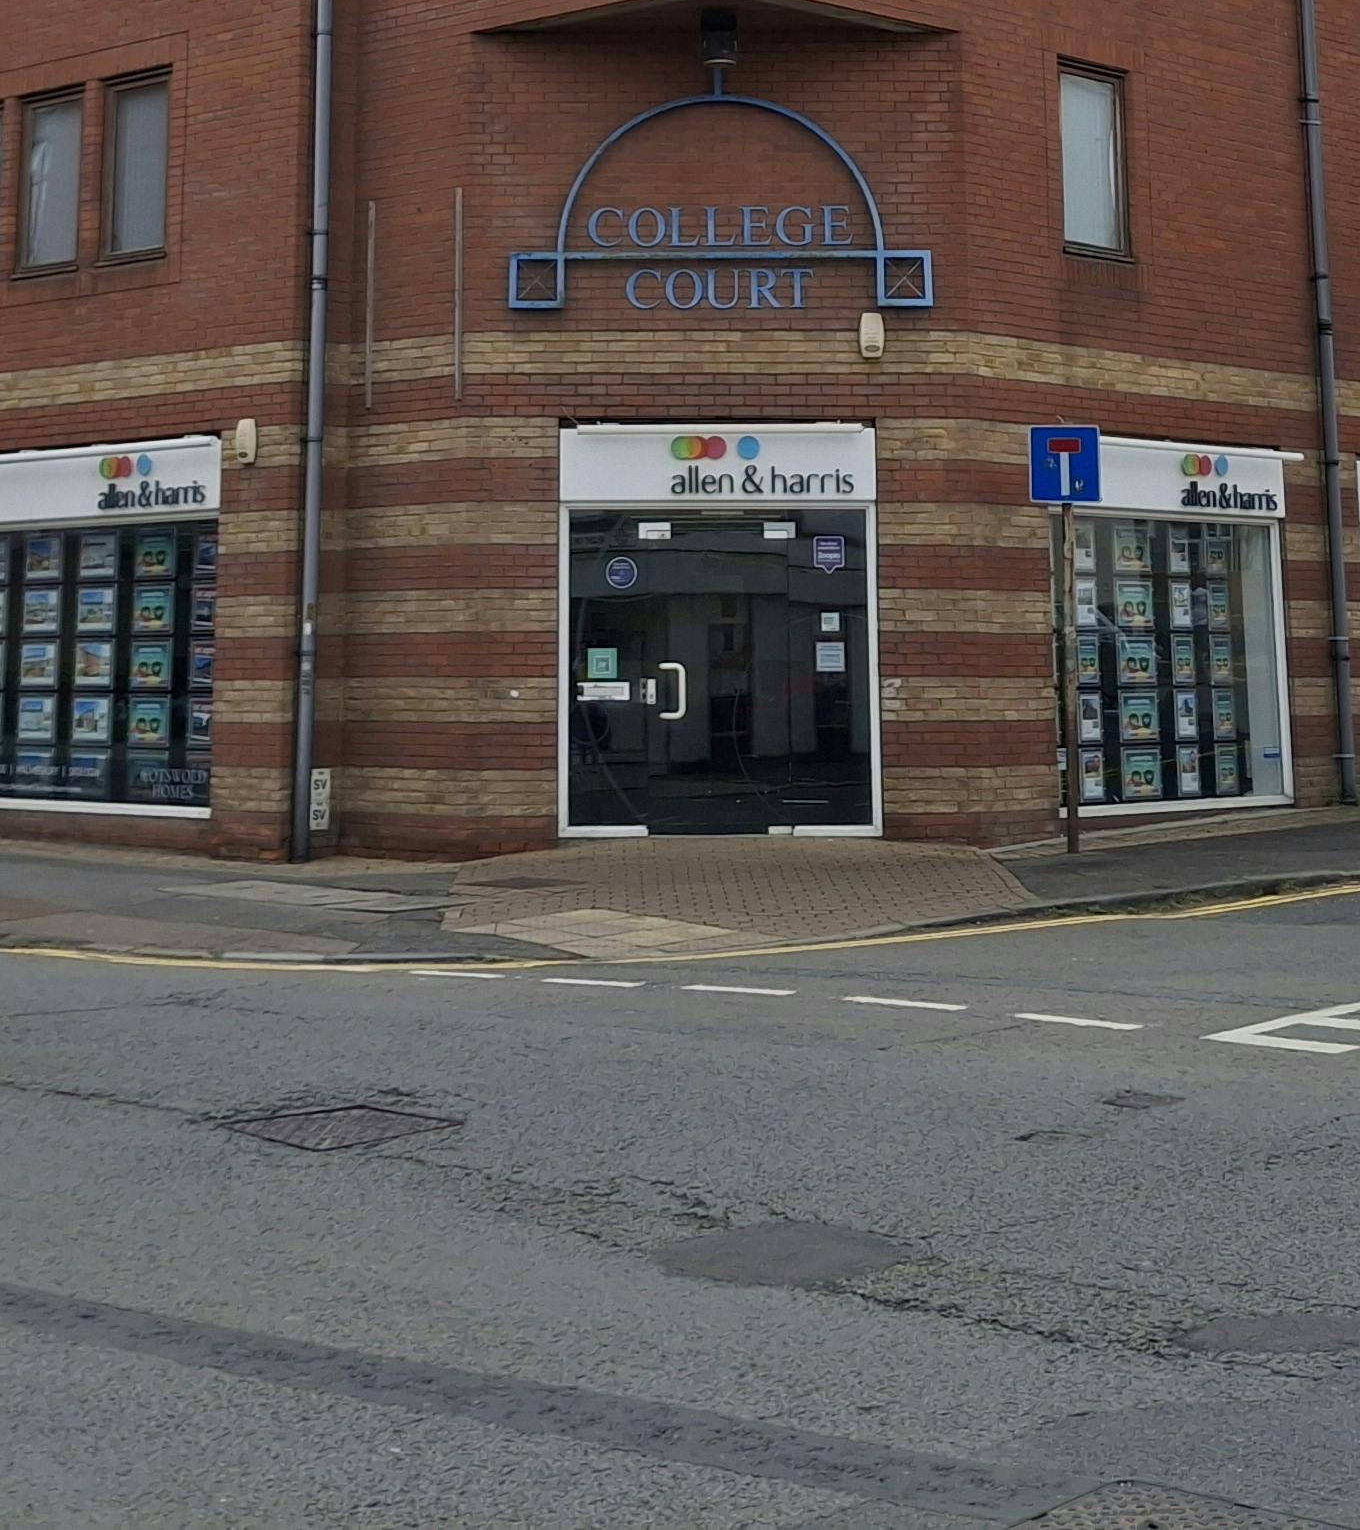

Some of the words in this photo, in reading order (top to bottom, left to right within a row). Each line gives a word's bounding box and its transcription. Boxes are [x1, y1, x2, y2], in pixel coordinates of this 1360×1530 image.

[587, 205, 854, 248] COLLEGE
[625, 268, 815, 310] COURT
[671, 465, 734, 494] allen
[741, 465, 764, 494] &
[771, 466, 854, 494] harris
[98, 483, 136, 509] allen
[138, 480, 152, 507] &
[154, 480, 206, 505] harris
[1181, 481, 1217, 507] allen
[1218, 483, 1232, 509] &
[1232, 484, 1278, 510] harris
[151, 784, 194, 799] HOMES
[313, 779, 328, 790] SV
[312, 809, 327, 821] SV
